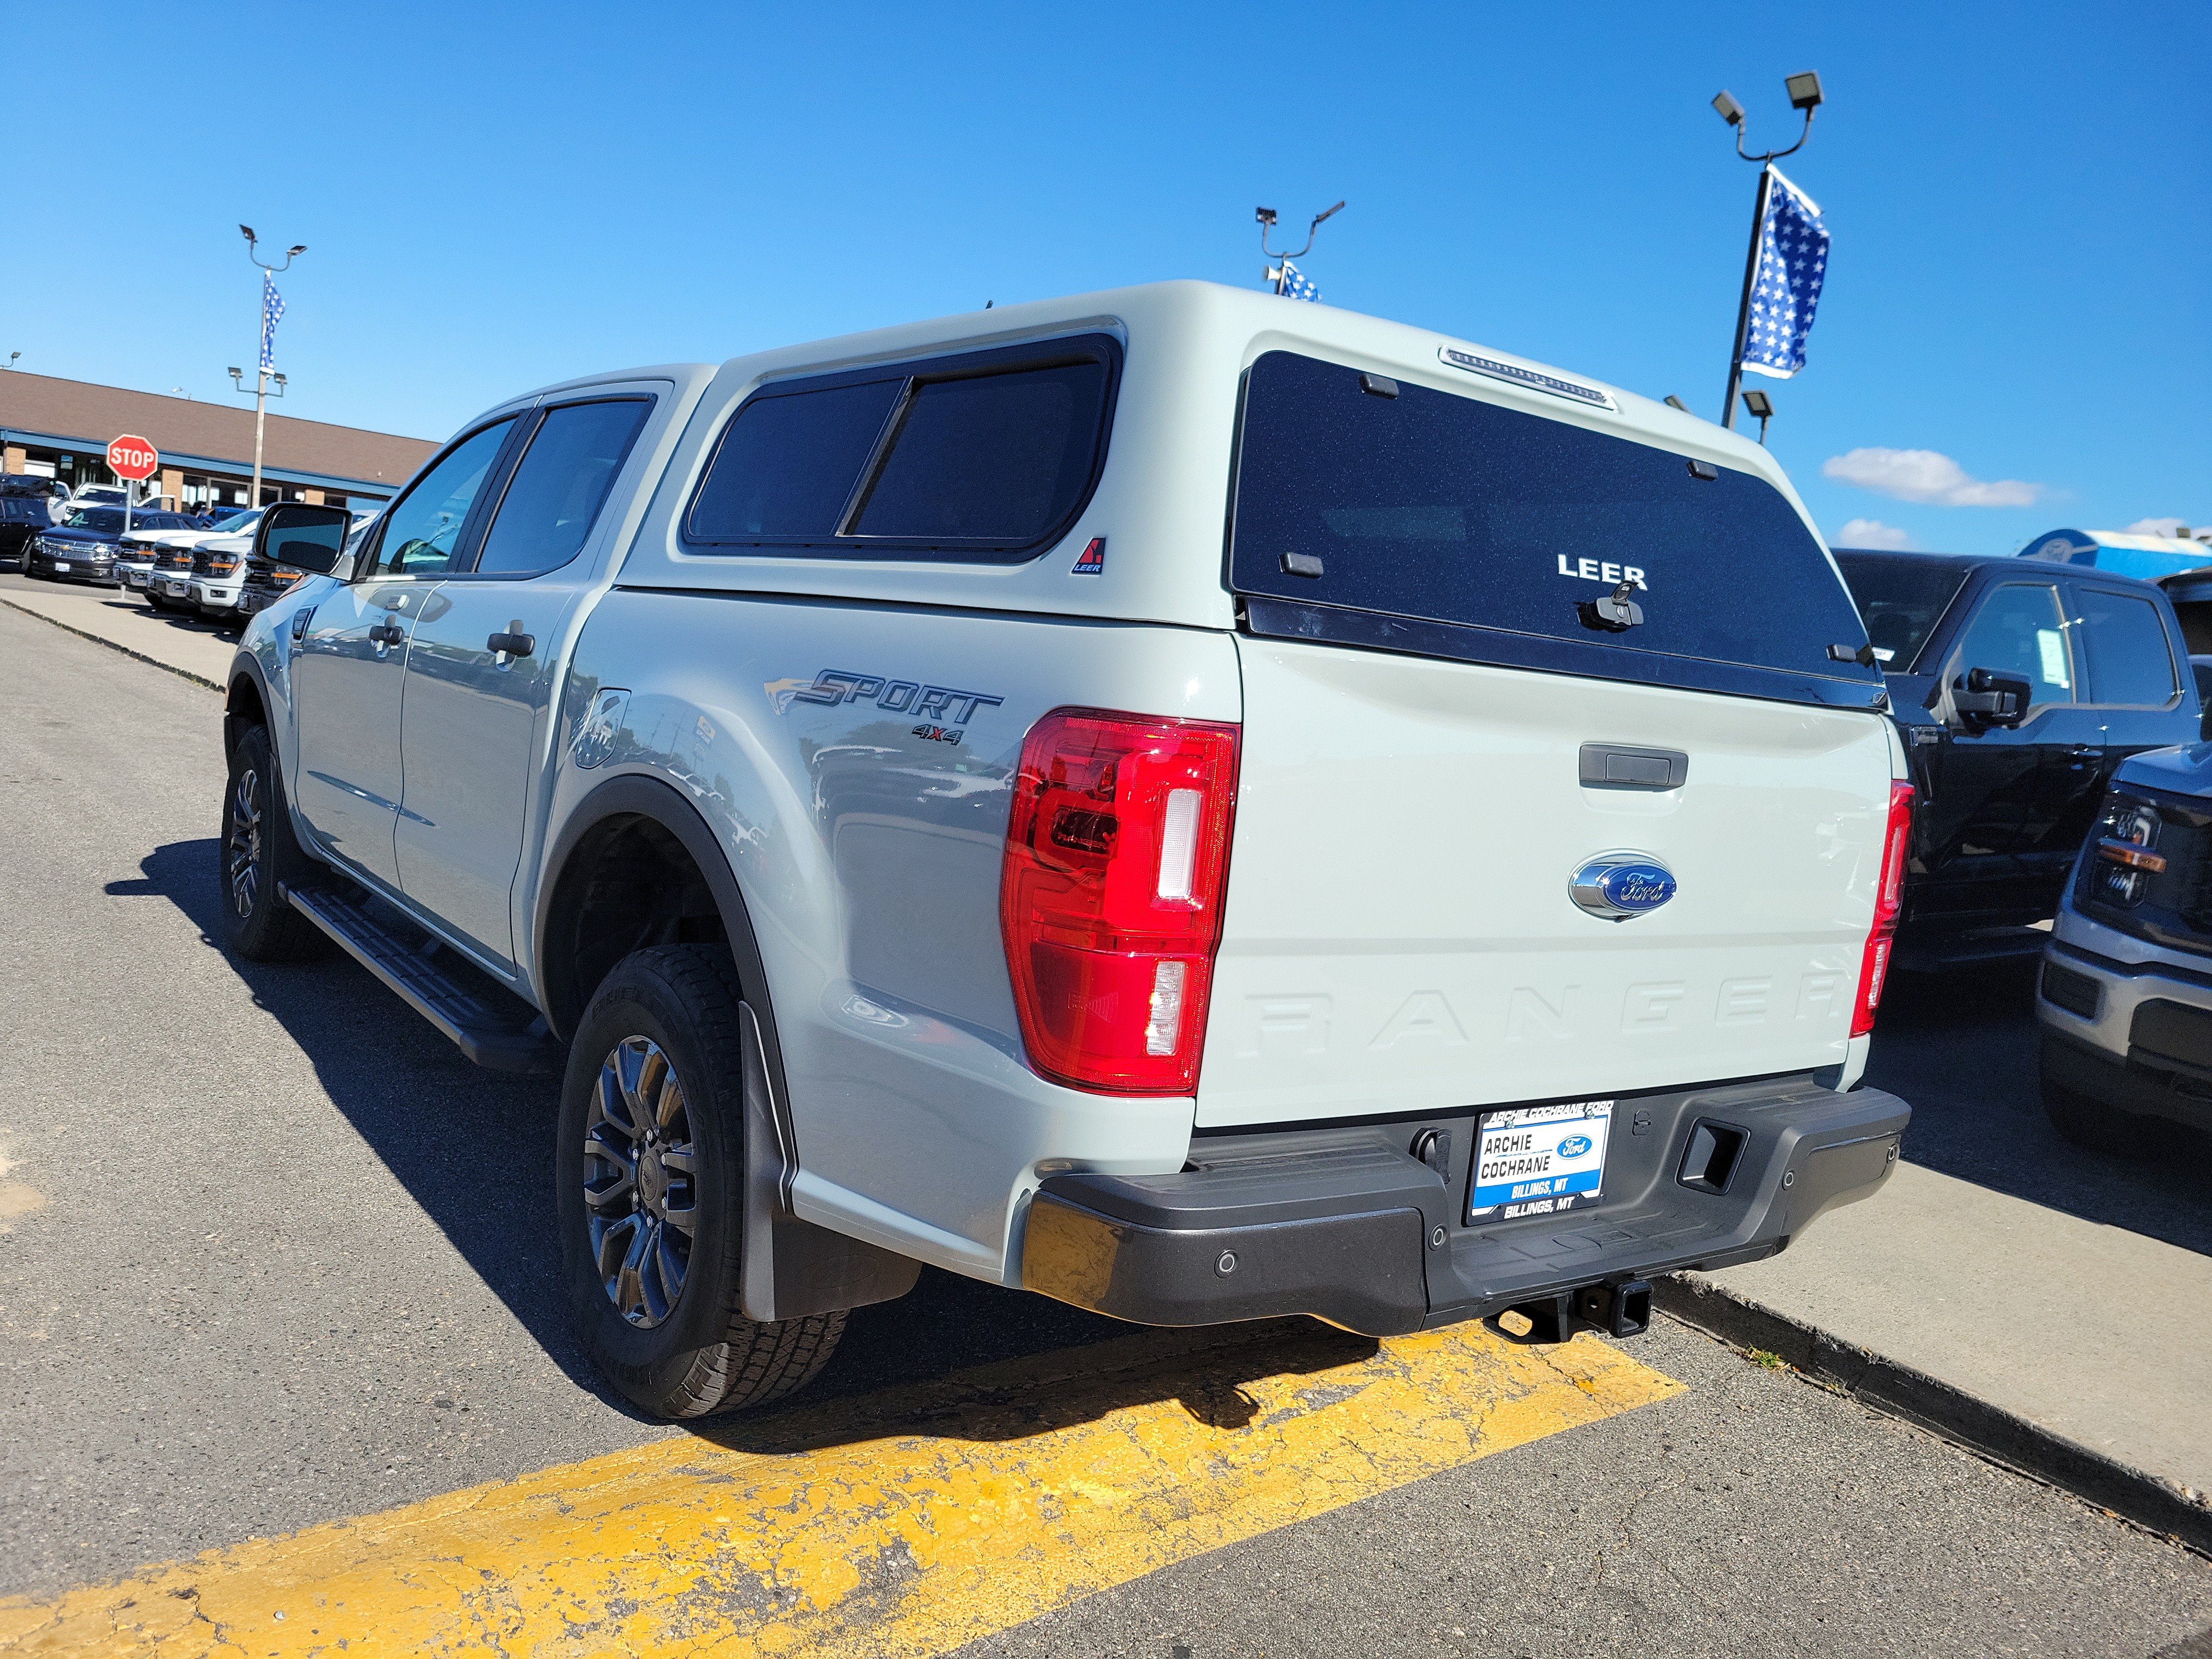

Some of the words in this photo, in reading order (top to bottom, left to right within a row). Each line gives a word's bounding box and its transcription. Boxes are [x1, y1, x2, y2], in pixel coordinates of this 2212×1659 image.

[111, 447, 154, 468] STOP
[1074, 564, 1102, 572] LEER
[1558, 554, 1648, 591] LEER
[793, 668, 1007, 725] SPORT
[1620, 871, 1666, 902] Ford
[1234, 969, 1851, 1060] RANGER
[1489, 1108, 1530, 1124] ARCHIE
[1528, 1102, 1587, 1118] COCHRANE
[1585, 1100, 1615, 1113] FORD
[1484, 1134, 1532, 1155] ARCHIE
[1562, 1137, 1587, 1156] Ford
[1481, 1155, 1551, 1180] COCHRANE
[1511, 1180, 1553, 1200] BILLINGS,
[1553, 1177, 1569, 1193] MT
[1504, 1199, 1554, 1219] BILLINGS,
[1556, 1196, 1576, 1211] MT
